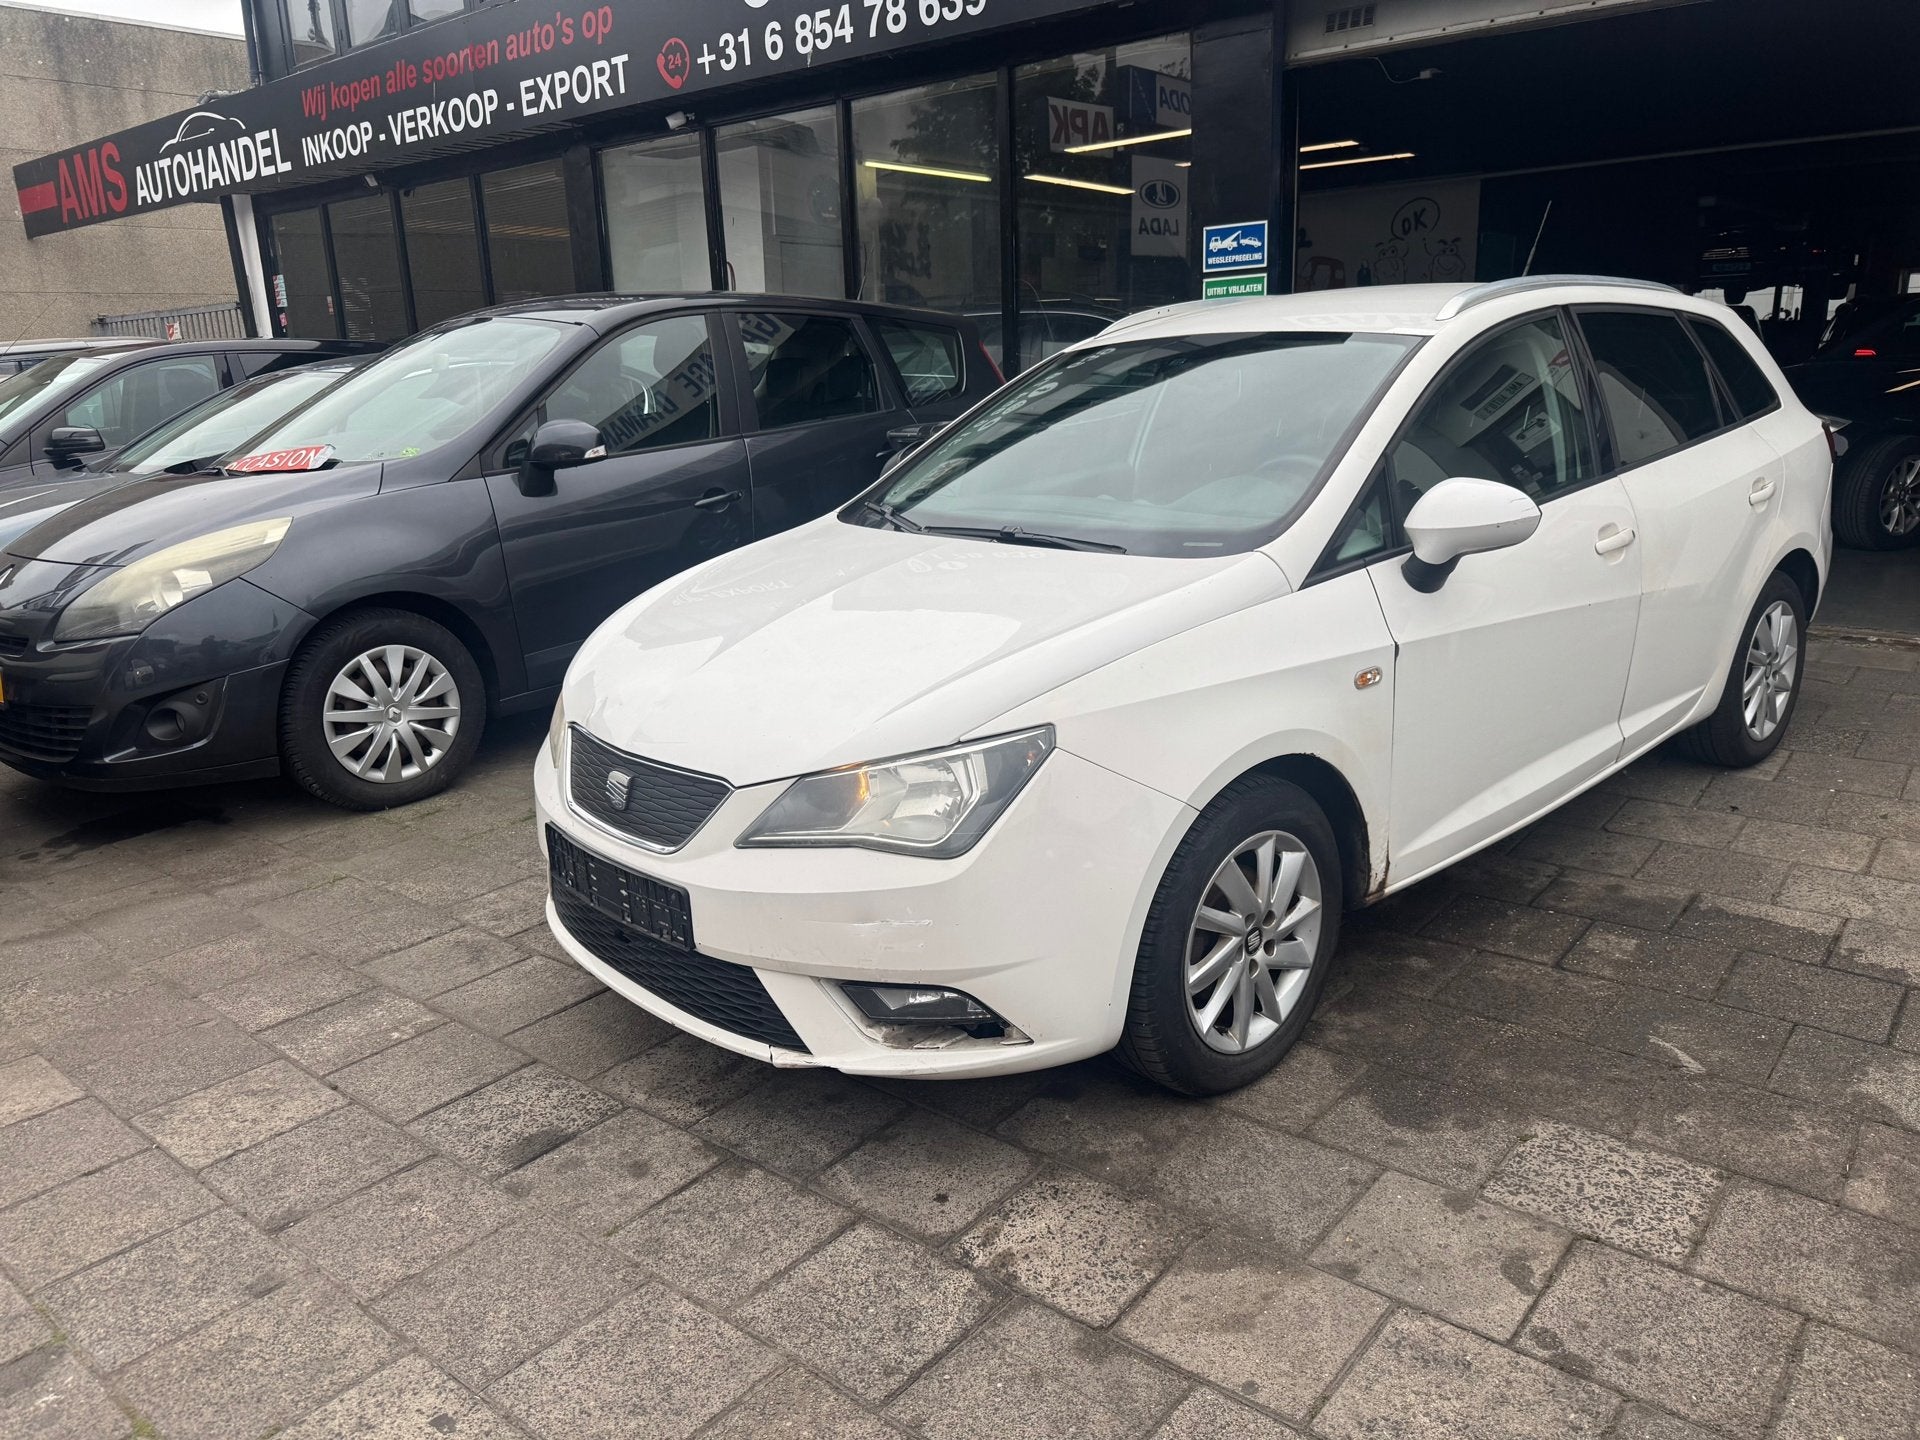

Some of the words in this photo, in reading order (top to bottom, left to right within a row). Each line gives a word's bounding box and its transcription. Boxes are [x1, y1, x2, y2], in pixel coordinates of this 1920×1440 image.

[302, 84, 327, 121] Wij
[331, 75, 381, 112] kopen
[386, 59, 417, 94] alle
[422, 39, 499, 84] soorten
[582, 5, 613, 45] op
[667, 52, 682, 70] 24
[697, 27, 751, 75] +31
[764, 21, 784, 61] 6
[795, 4, 854, 54] 854
[864, 0, 907, 38] 78
[302, 121, 373, 167] INKOOP
[388, 89, 499, 146] VERKOOP
[520, 53, 629, 117] EXPORT
[58, 141, 128, 224] AMS
[135, 128, 292, 206] AUTOHANDEL
[1207, 252, 1263, 264] WEGSLEEPREGELING
[1207, 287, 1227, 296] UITRIT
[1228, 283, 1262, 294] VRIJLATEN
[225, 448, 322, 470] OCCASION
